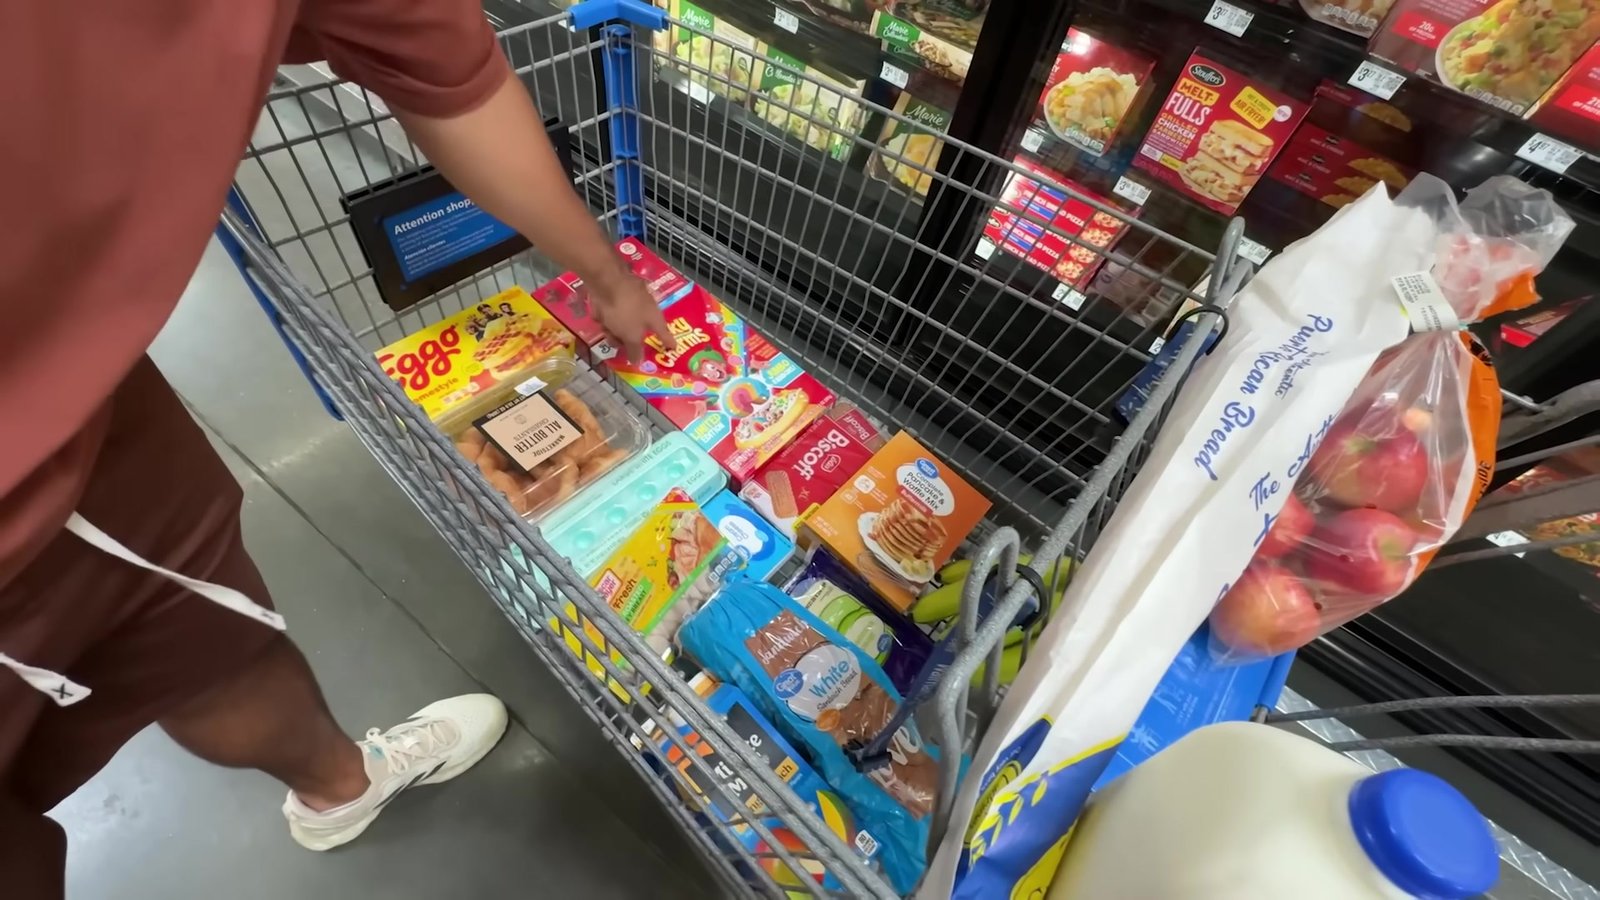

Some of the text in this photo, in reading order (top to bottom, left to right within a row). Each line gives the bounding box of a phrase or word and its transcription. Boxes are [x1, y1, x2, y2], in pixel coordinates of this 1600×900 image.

[906, 104, 945, 127] Marie
[1165, 92, 1211, 126] FULLS
[1158, 117, 1196, 140] CHICKEN
[394, 208, 446, 235] Attention
[445, 197, 476, 214] shop
[655, 327, 711, 369] Charms
[412, 376, 460, 404] omestyle
[513, 419, 562, 454] ALL BUTTER
[843, 411, 870, 440] Biscoff
[1194, 401, 1256, 481] Bread
[791, 428, 851, 482] Biscoff
[902, 477, 940, 511] Waffle Mix
[906, 472, 941, 502] Pancake
[916, 471, 945, 497] Complete
[1249, 471, 1281, 512] The
[612, 577, 637, 610] Fresh
[808, 659, 851, 700] White
